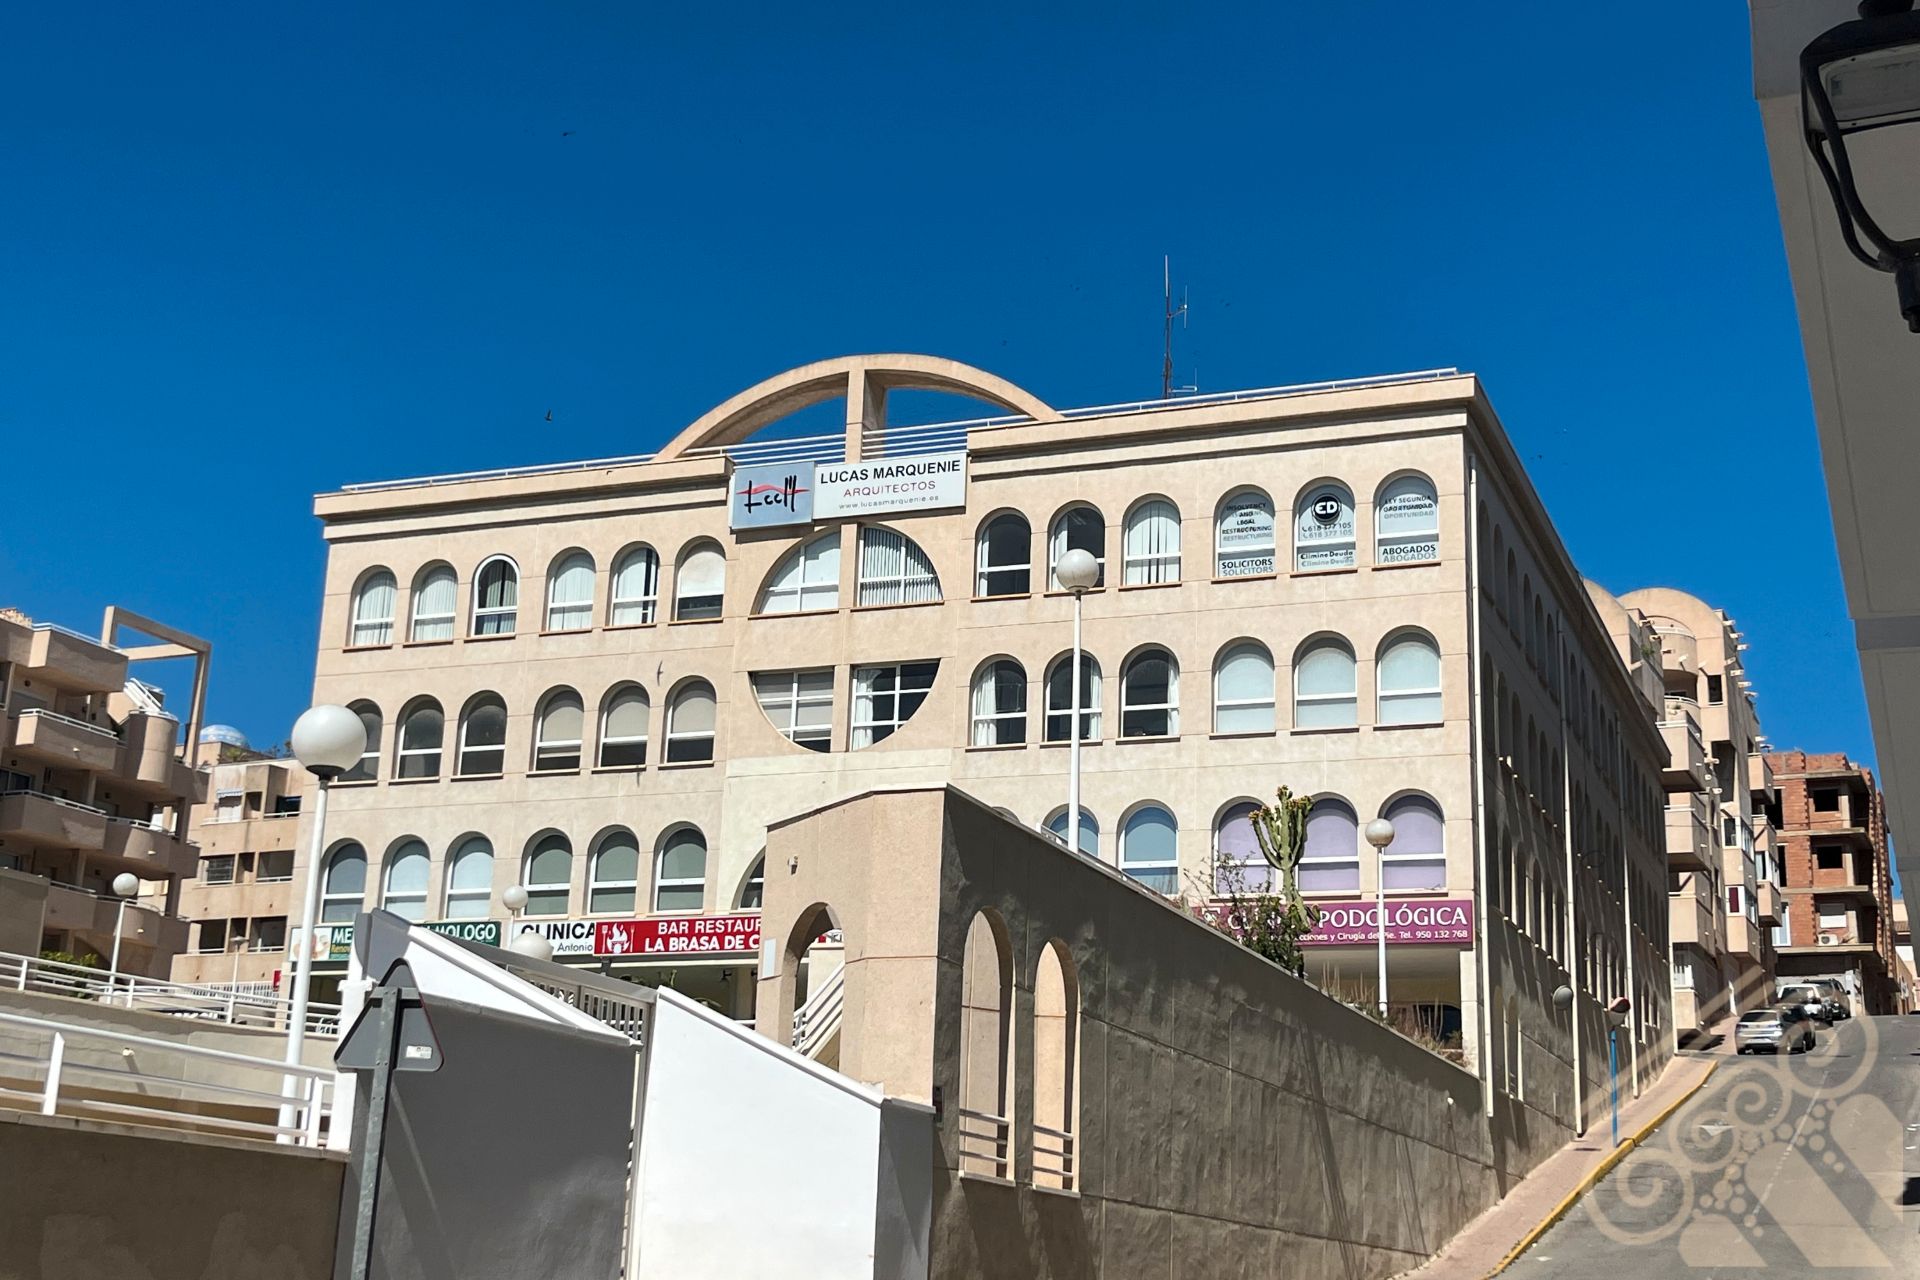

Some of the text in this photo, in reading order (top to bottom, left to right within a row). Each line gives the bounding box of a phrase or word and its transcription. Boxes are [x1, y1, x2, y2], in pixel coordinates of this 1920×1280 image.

[820, 460, 960, 484] LUCAS MARQUENIE
[843, 481, 936, 498] ARQUITECTOS
[1382, 544, 1436, 555] ABOGADOS
[1221, 558, 1273, 569] SOLICITORS
[1318, 903, 1468, 929] PODOLÓGICA
[657, 921, 689, 935] BAR
[1330, 934, 1336, 942] y
[1337, 932, 1366, 942] Cirugía
[1399, 931, 1414, 939] Tel.
[1415, 930, 1432, 939] 950
[1434, 930, 1450, 938] 132
[1452, 929, 1468, 938] 768
[556, 942, 593, 952] Antonio
[644, 937, 665, 952] LA
[668, 935, 720, 951] BRASA
[724, 934, 745, 949] DE
